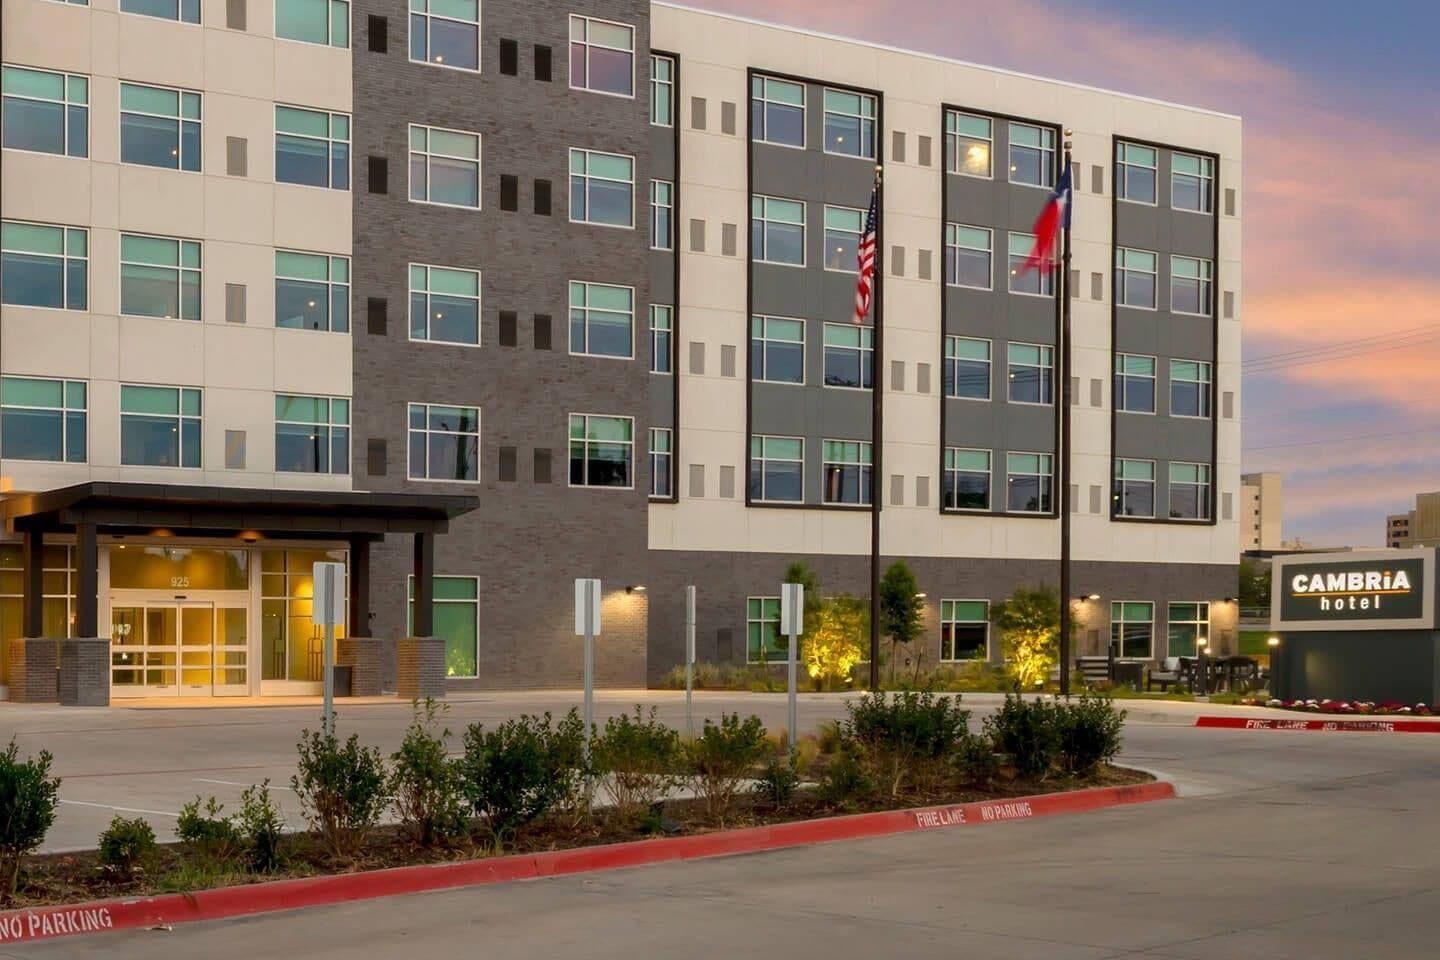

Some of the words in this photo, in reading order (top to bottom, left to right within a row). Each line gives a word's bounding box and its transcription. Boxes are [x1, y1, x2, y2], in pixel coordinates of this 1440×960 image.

[171, 576, 190, 587] 925
[1320, 595, 1380, 610] hotel
[1246, 720, 1271, 729] FIRE
[1277, 720, 1308, 730] LANE
[915, 812, 940, 827] FIRE
[940, 809, 966, 825] LANE
[981, 806, 994, 820] NO
[994, 802, 1032, 819] PARKING
[27, 908, 113, 937] PARKING
